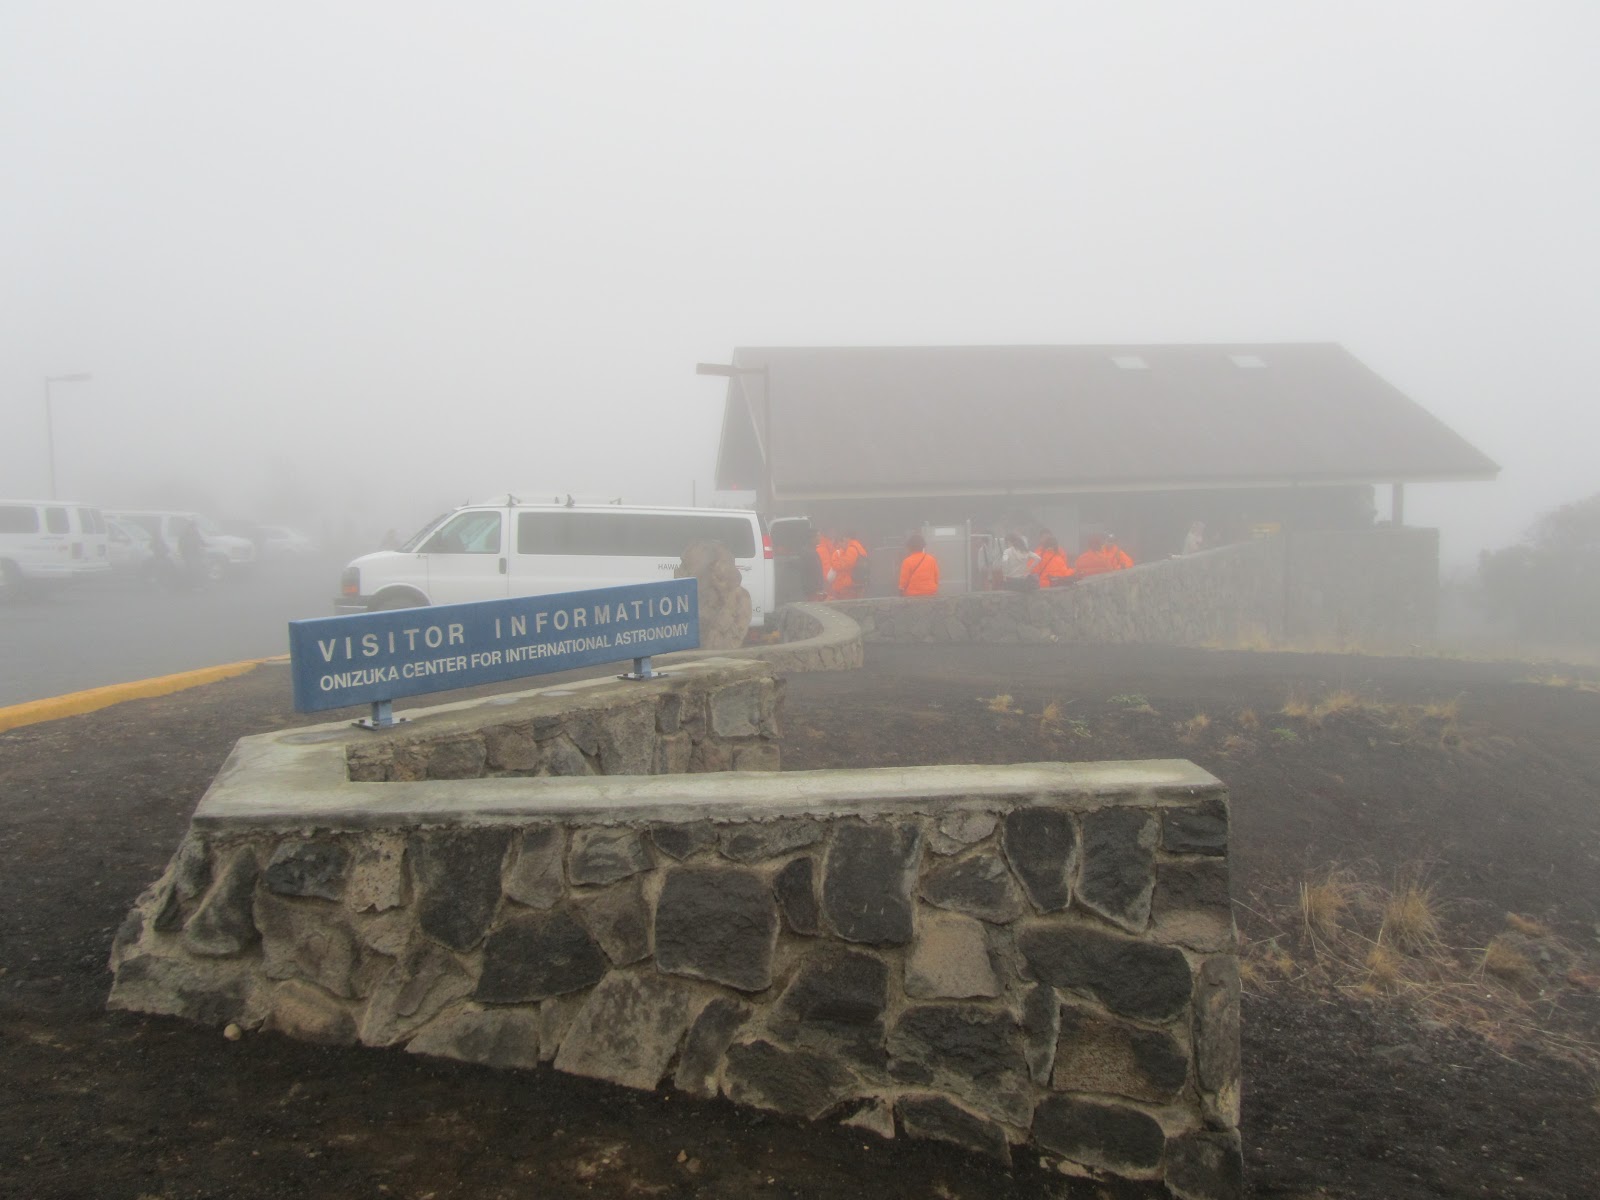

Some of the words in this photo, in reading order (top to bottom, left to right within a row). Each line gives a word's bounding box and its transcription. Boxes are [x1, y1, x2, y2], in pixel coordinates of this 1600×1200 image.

[318, 623, 465, 662] VISITOR
[495, 594, 690, 639] INFORMATION
[320, 665, 400, 692] ONIZUKA
[402, 655, 467, 679] CENTER
[471, 650, 502, 669] FOR
[505, 635, 612, 663] INTERNATIONAL
[614, 622, 689, 646] ASTRONOMY
